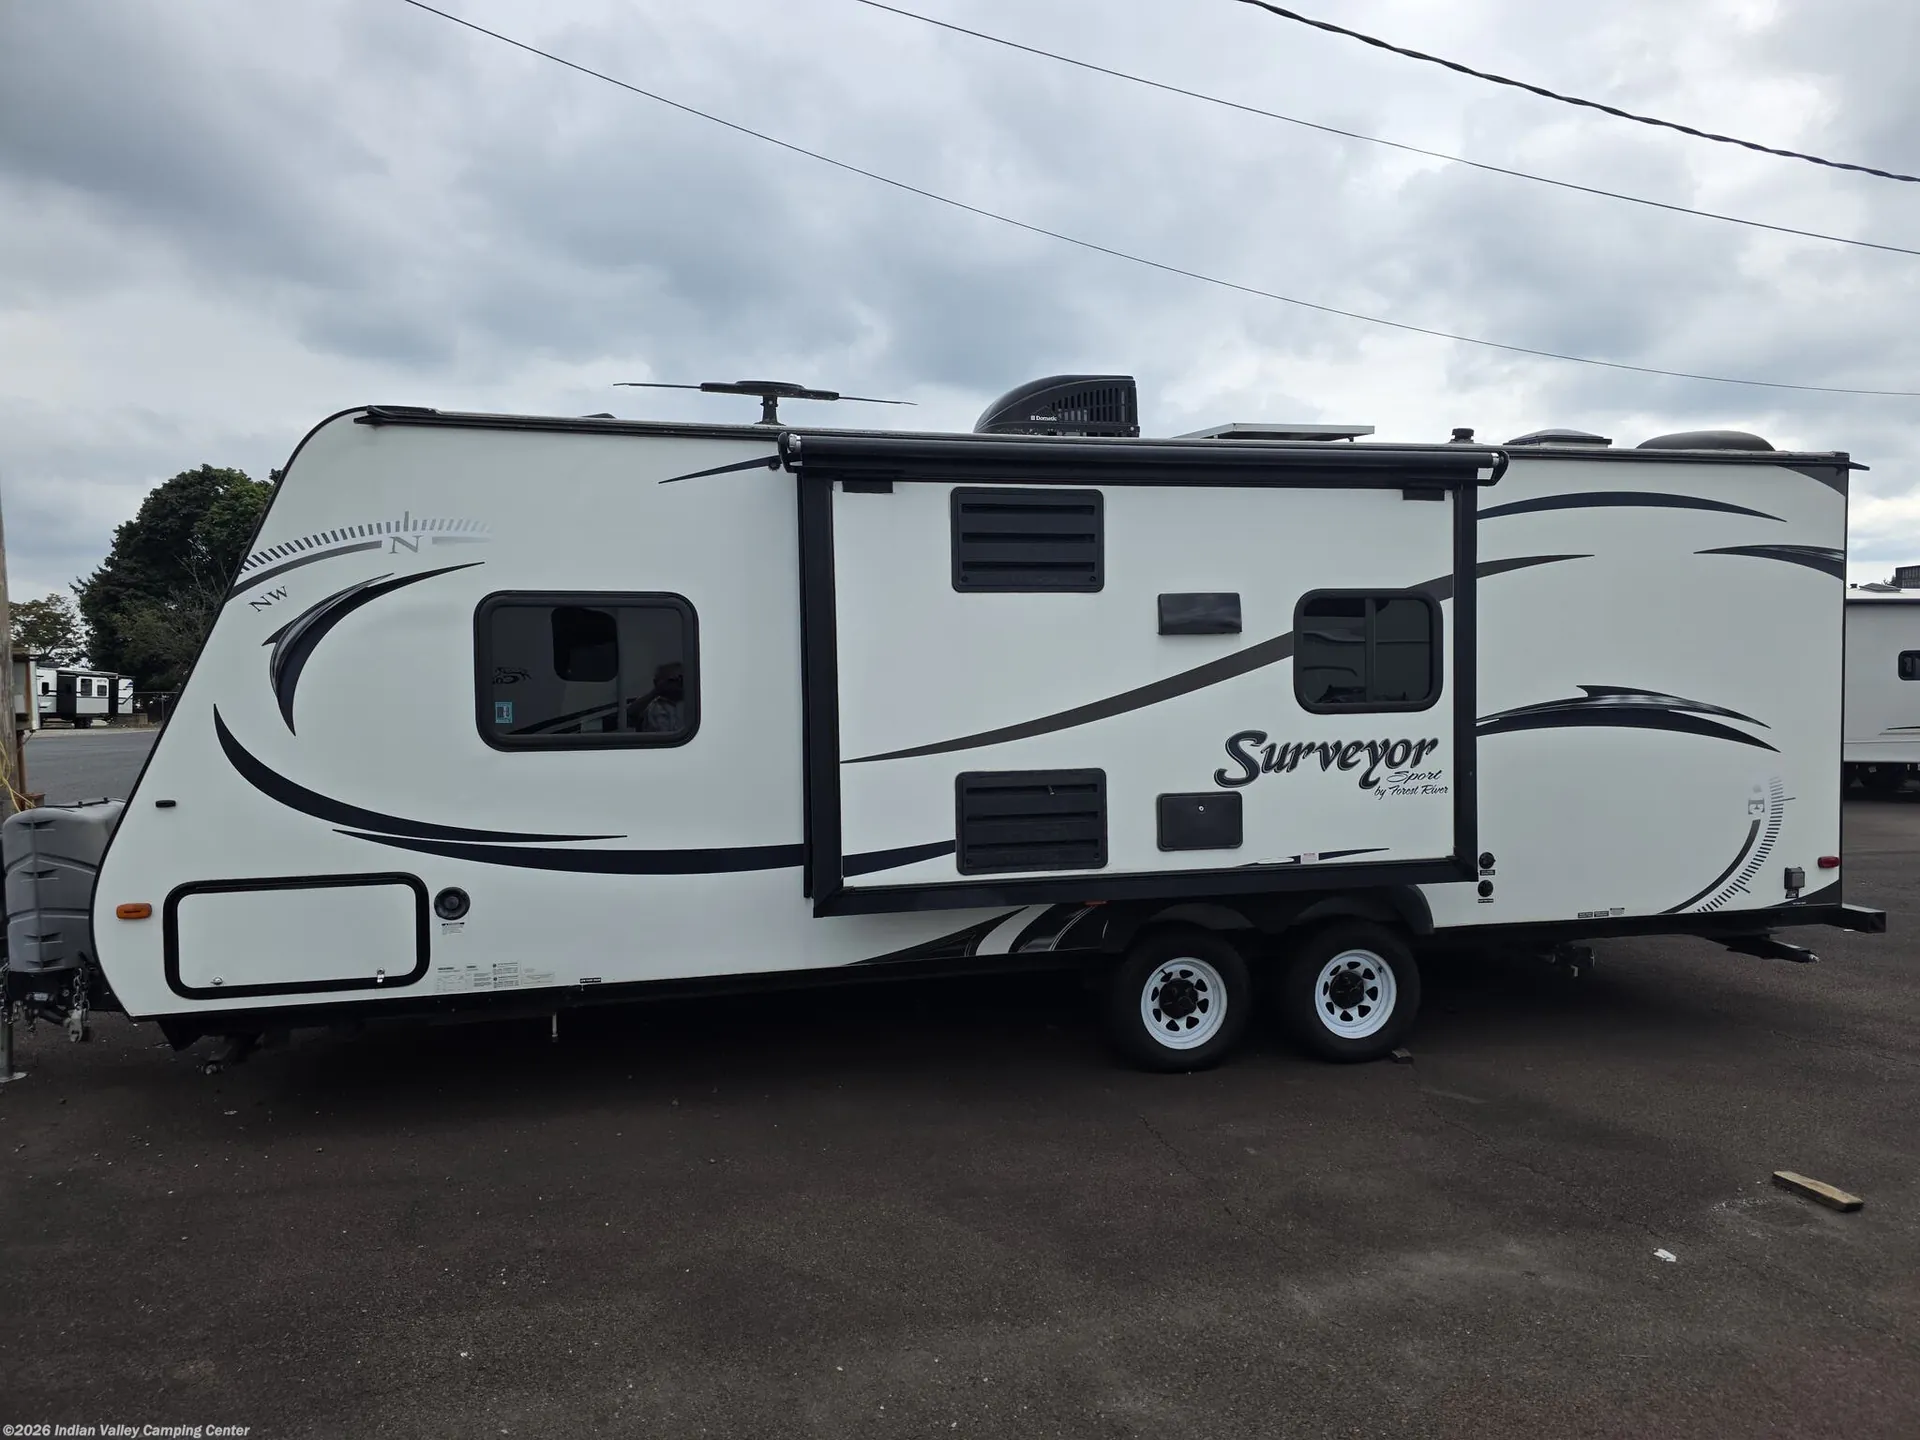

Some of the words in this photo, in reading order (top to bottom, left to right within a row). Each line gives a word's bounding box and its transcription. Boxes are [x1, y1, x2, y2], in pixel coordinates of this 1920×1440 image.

[388, 534, 424, 554] N
[248, 585, 288, 612] NW
[1214, 730, 1439, 789] Surveyor
[1386, 770, 1442, 784] Sport
[1374, 786, 1387, 800] by
[1388, 785, 1419, 796] Forest
[1420, 784, 1449, 795] River
